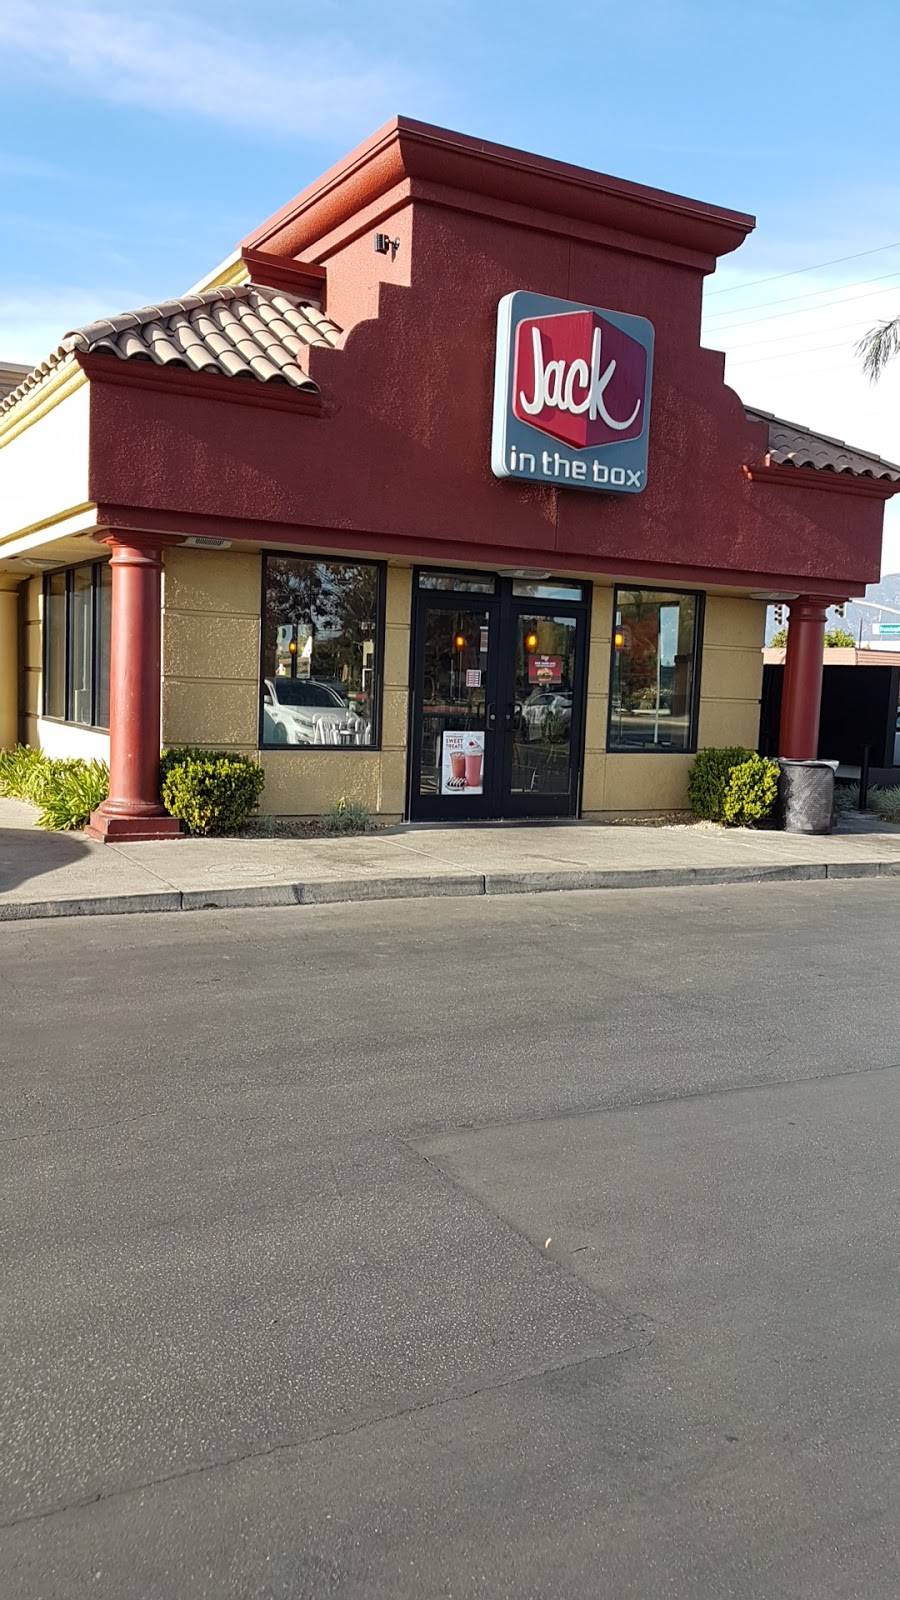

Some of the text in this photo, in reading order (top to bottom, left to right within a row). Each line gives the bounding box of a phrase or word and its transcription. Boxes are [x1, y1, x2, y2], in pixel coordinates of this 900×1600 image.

[520, 327, 641, 430] Jack
[510, 445, 641, 487] in the box
